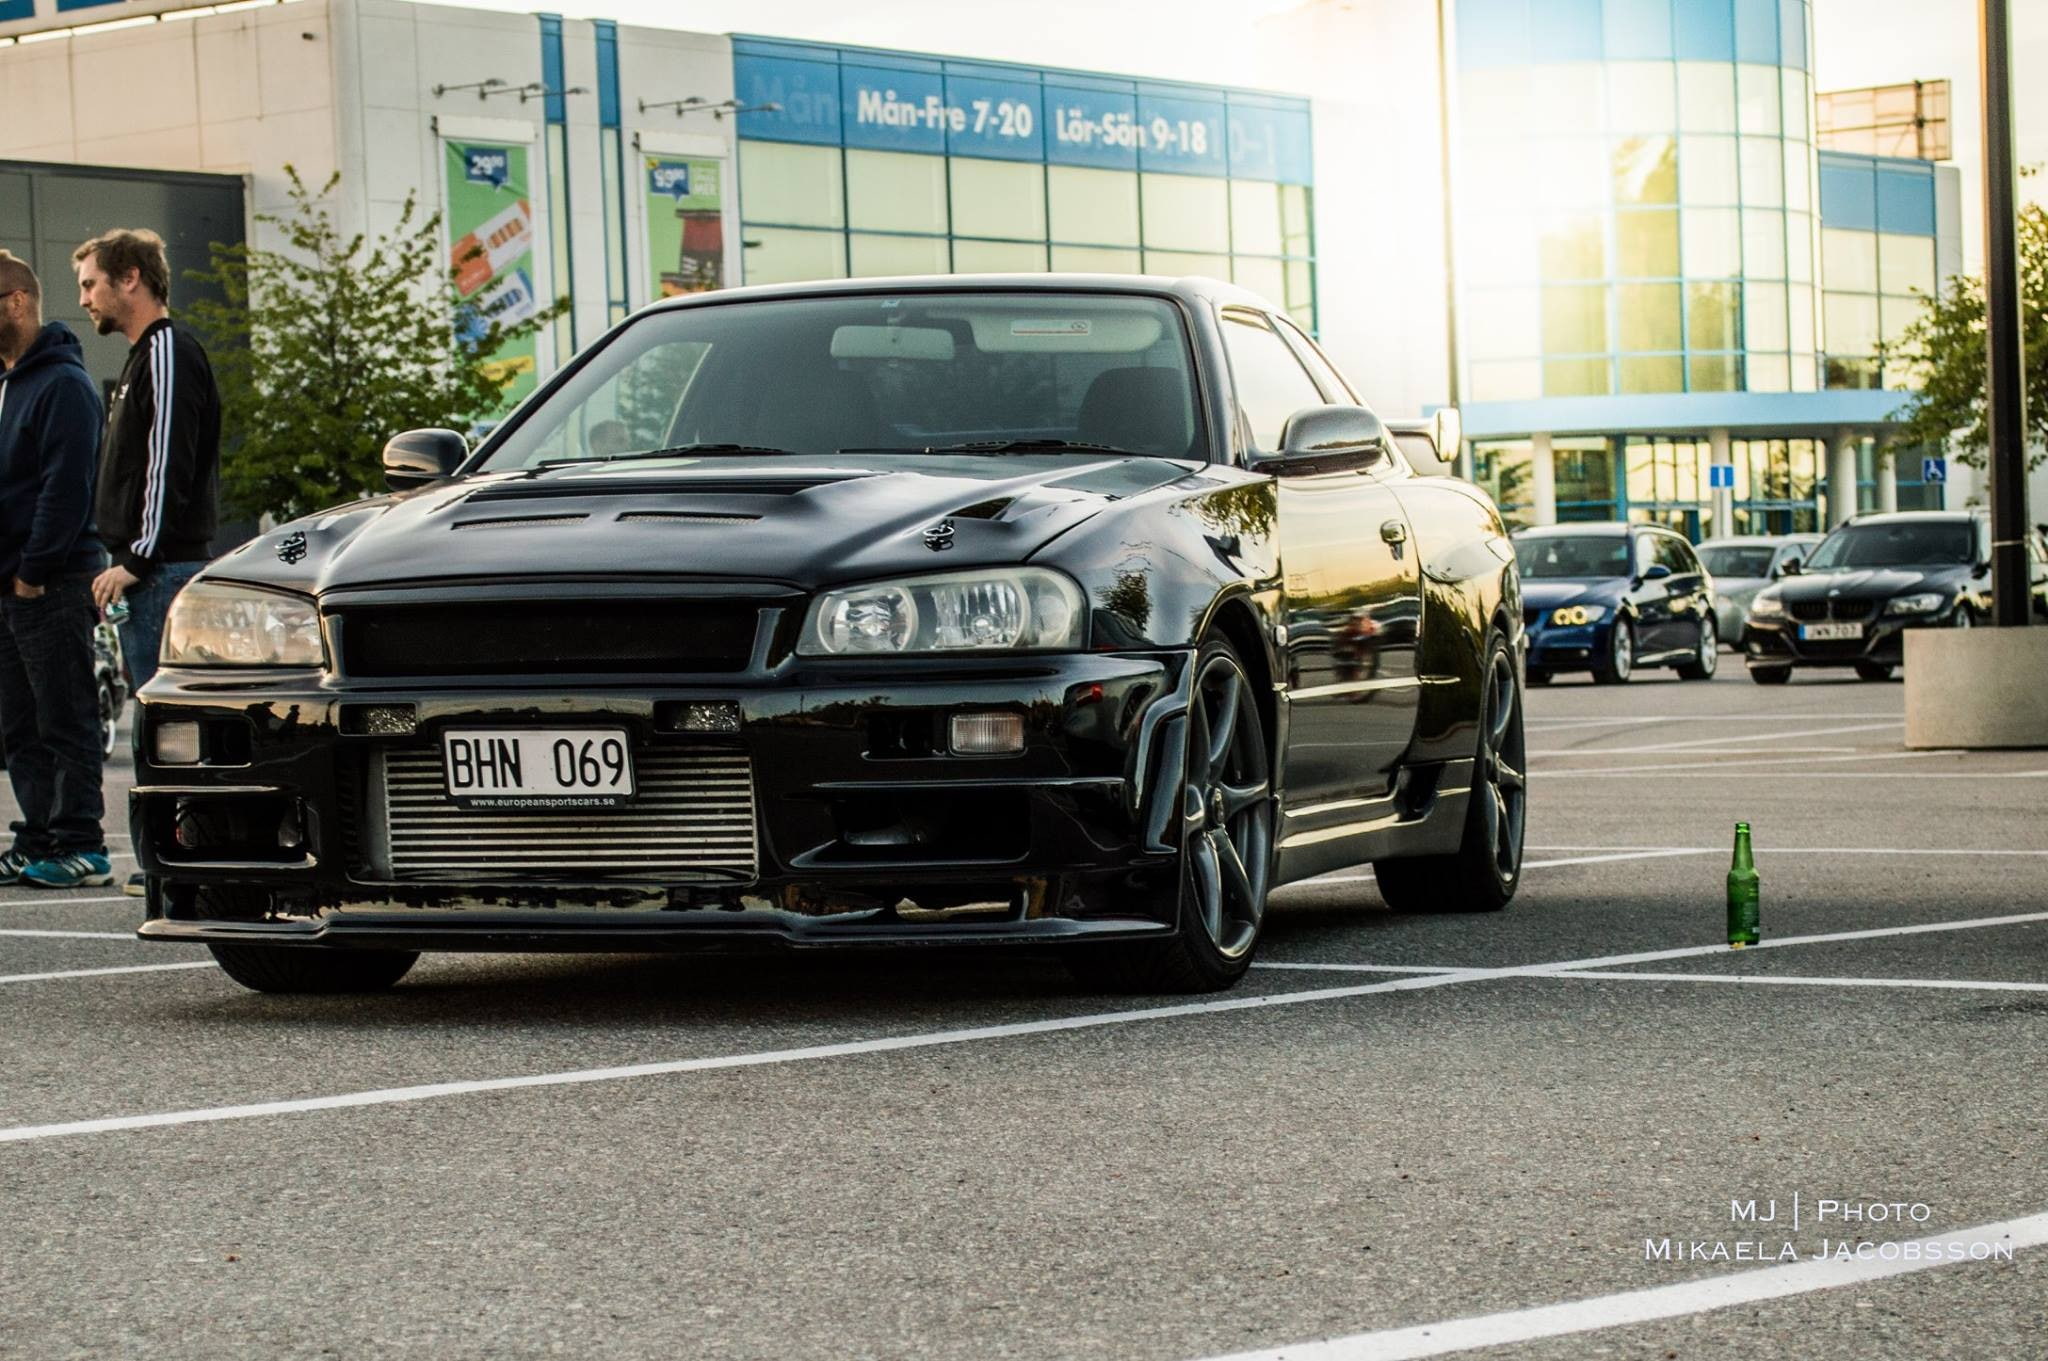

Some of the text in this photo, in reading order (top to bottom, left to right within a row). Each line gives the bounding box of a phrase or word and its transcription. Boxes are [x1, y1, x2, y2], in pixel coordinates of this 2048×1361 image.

[857, 89, 1034, 137] Mån-Fre 7-20
[1055, 106, 1207, 155] Lör-Sön 9-18
[450, 738, 624, 788] BHN 069
[470, 797, 616, 808] www.europeansportscars.se
